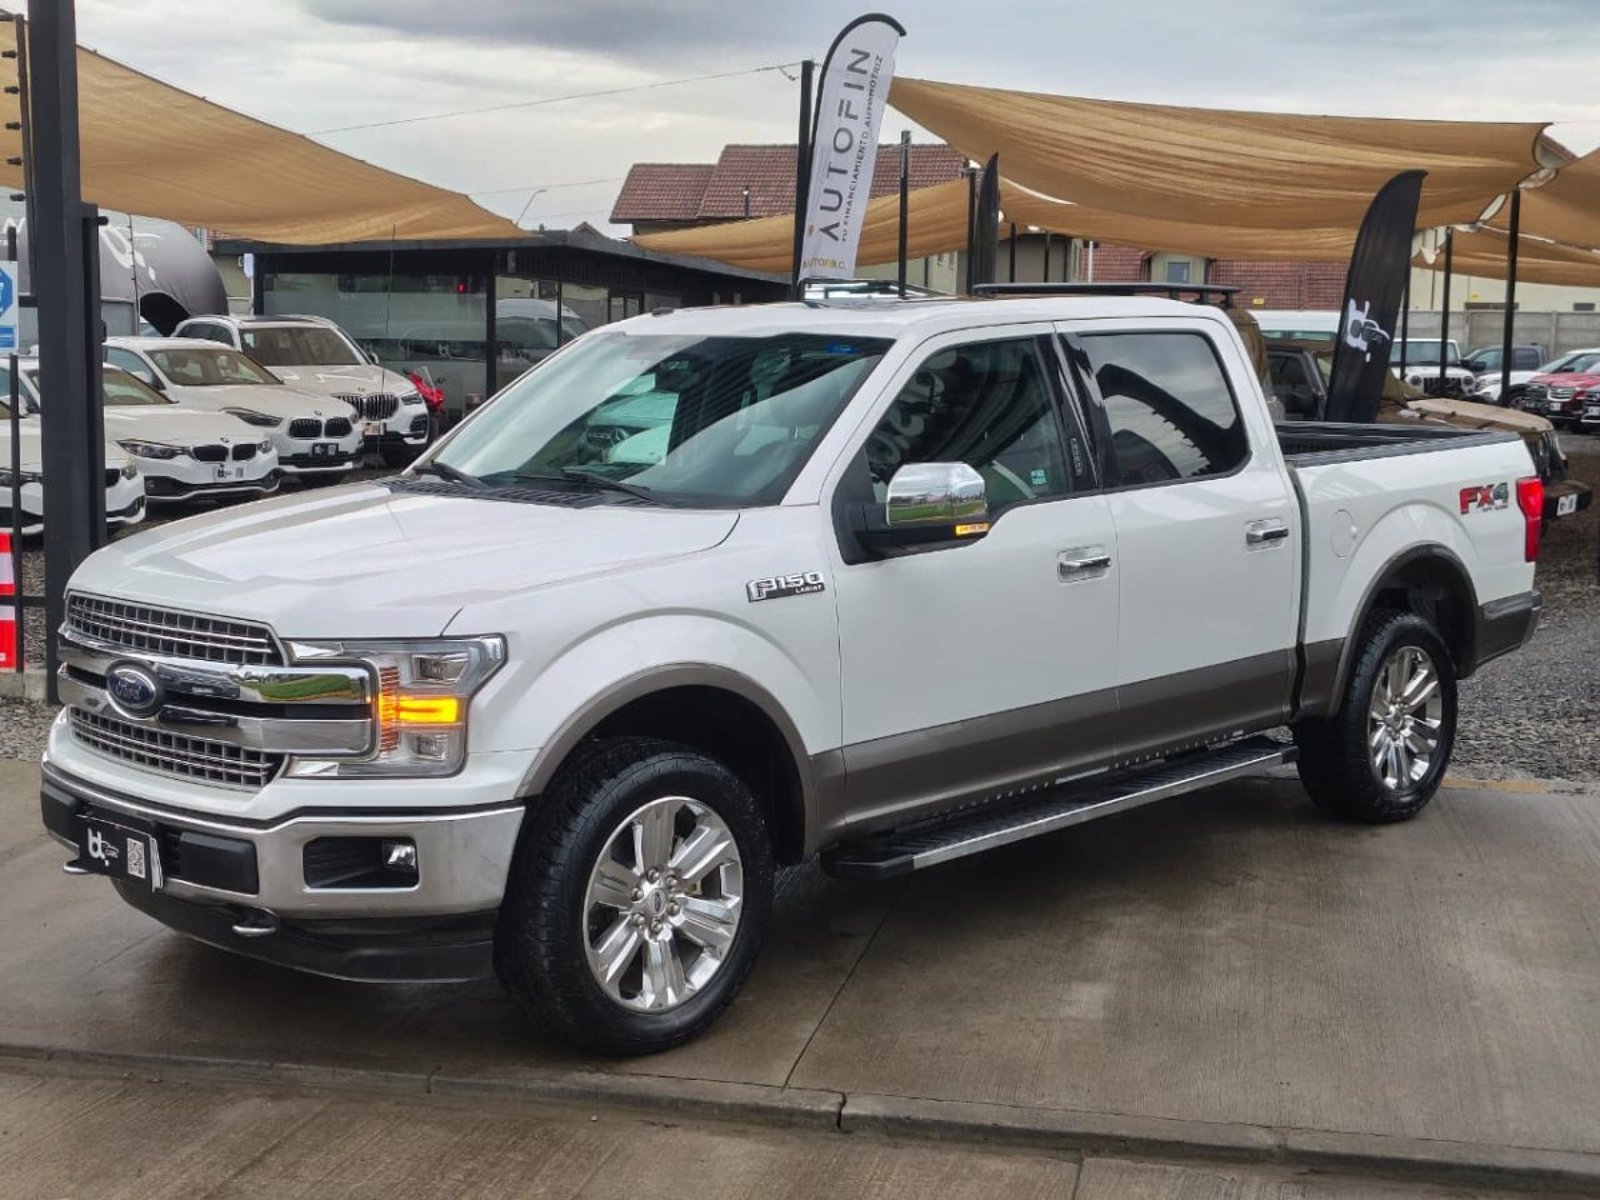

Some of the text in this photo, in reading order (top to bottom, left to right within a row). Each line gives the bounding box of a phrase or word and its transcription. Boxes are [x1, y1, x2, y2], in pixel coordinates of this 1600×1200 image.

[818, 48, 871, 242] AUTOFIN
[843, 131, 869, 226] FINANCIAMIENTO
[864, 54, 883, 128] AUTOMOTRIZ
[1459, 482, 1509, 515] FX4
